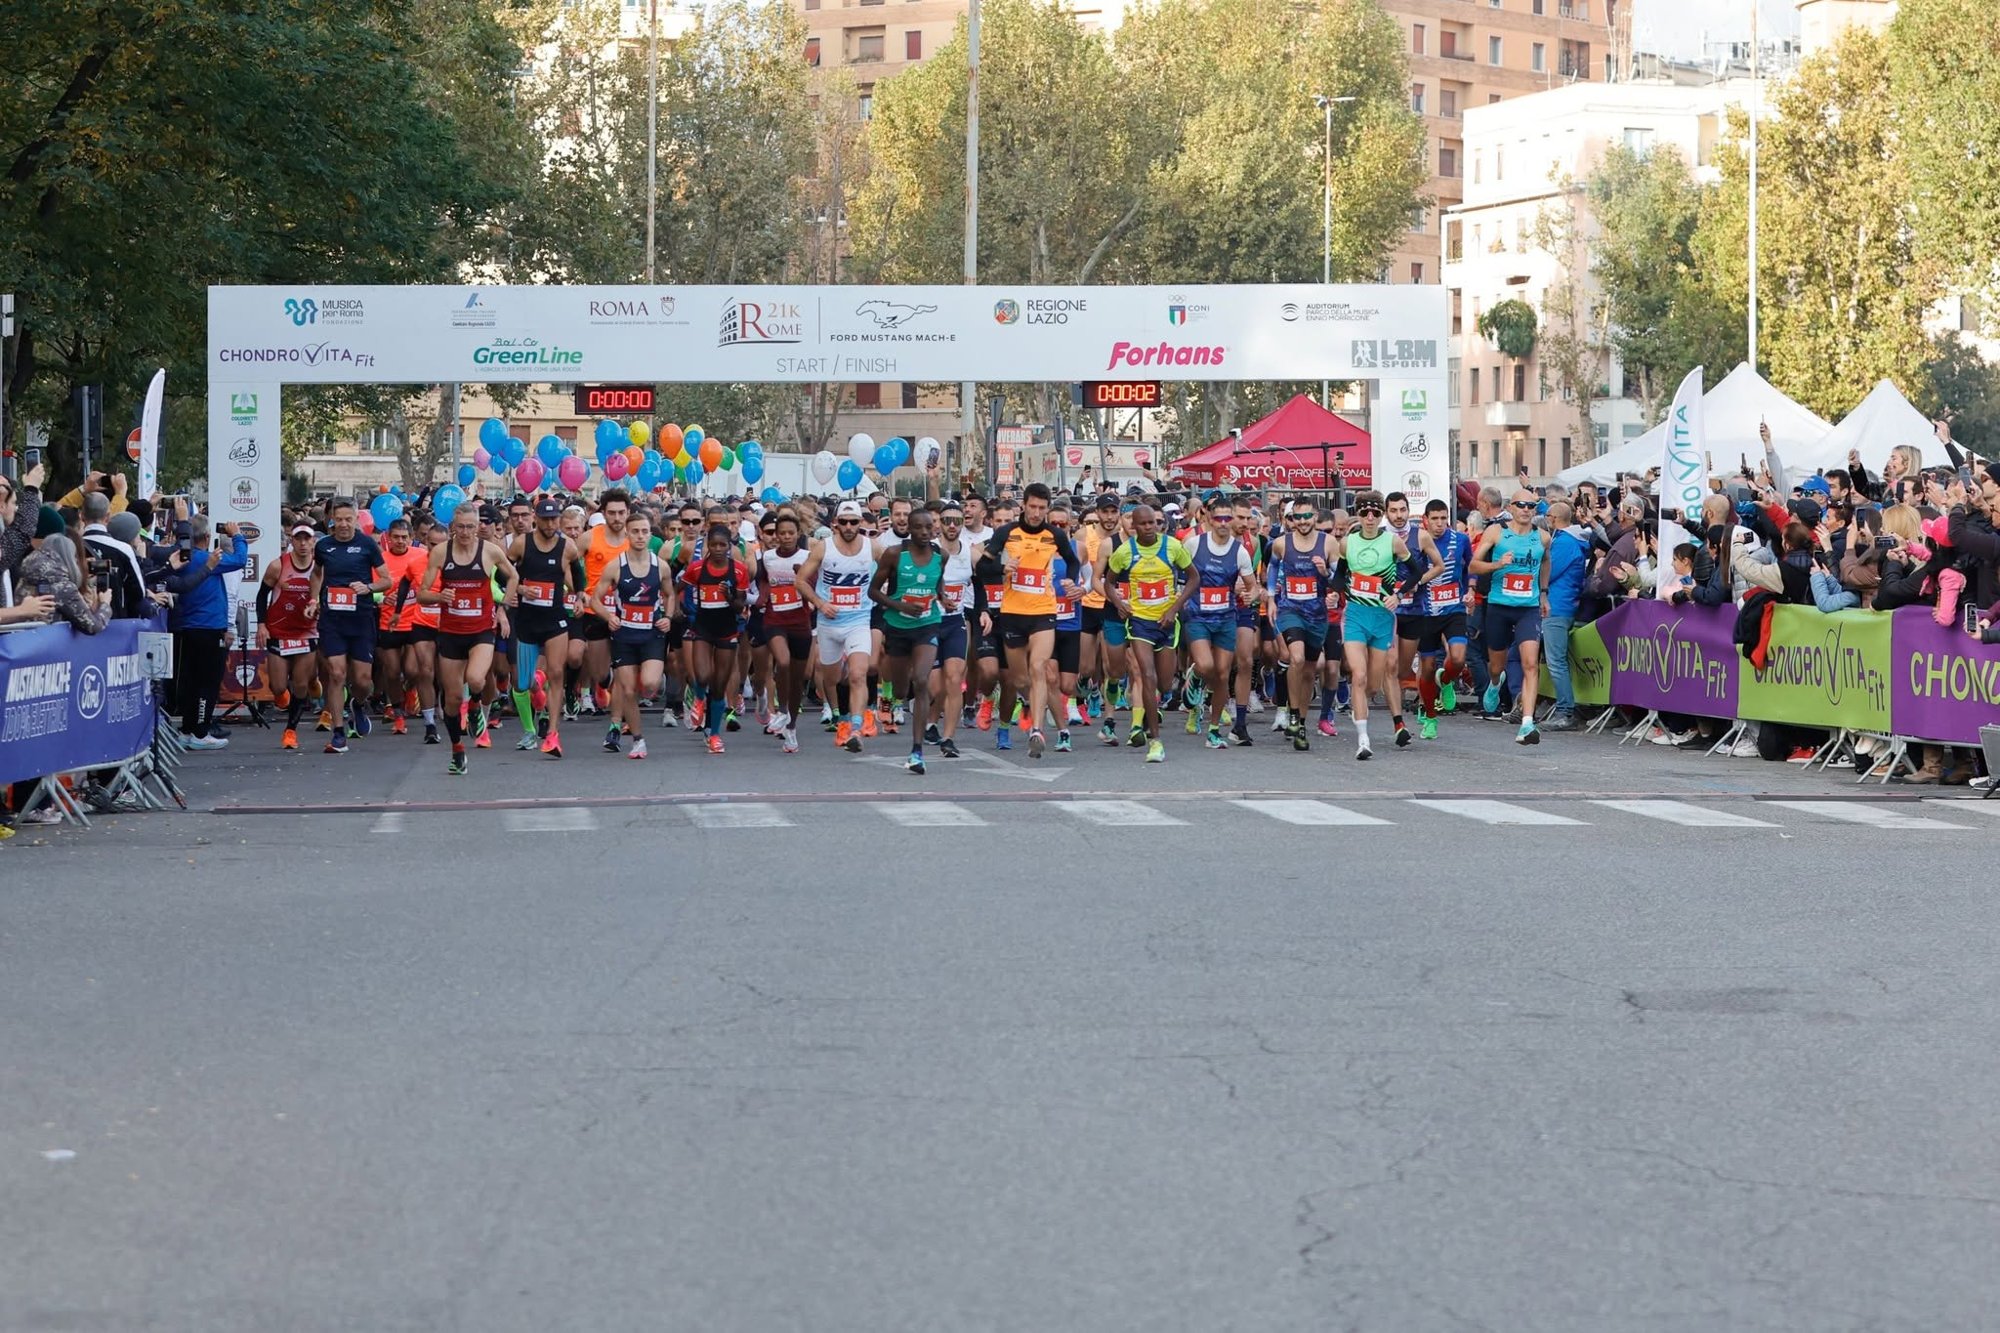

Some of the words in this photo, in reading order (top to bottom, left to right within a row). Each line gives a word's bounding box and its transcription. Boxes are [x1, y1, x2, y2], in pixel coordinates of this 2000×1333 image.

[322, 300, 363, 309] MUSICA
[590, 301, 649, 316] ROMA
[768, 303, 800, 318] 21K
[1027, 299, 1087, 311] REGIONE
[322, 310, 338, 318] per
[339, 309, 364, 317] Roma
[1027, 313, 1068, 324] LAZIO
[830, 334, 858, 342] FORD
[861, 334, 913, 342] MUSTANG
[916, 334, 956, 342] MACH-E
[219, 341, 352, 366] CHONDROVITA
[355, 354, 375, 367] Fit
[473, 346, 583, 364] GreenLine
[1106, 342, 1224, 370] Forhans
[1381, 340, 1437, 367] LBM
[776, 358, 827, 373] START
[845, 358, 897, 373] FINISH
[1381, 360, 1431, 368] SPORT
[1098, 385, 1156, 401] 0:00:02
[589, 391, 651, 408] 0:00:00
[1288, 468, 1372, 478] PROFEIONAL
[1513, 580, 1524, 590] 42
[336, 593, 347, 603] 30
[712, 591, 718, 600] 1
[783, 593, 790, 602] 2
[1150, 588, 1157, 598] 2
[458, 599, 470, 609] 32
[1706, 660, 1727, 699] Fit
[81, 672, 101, 710] Ford
[1868, 669, 1885, 711] Fit
